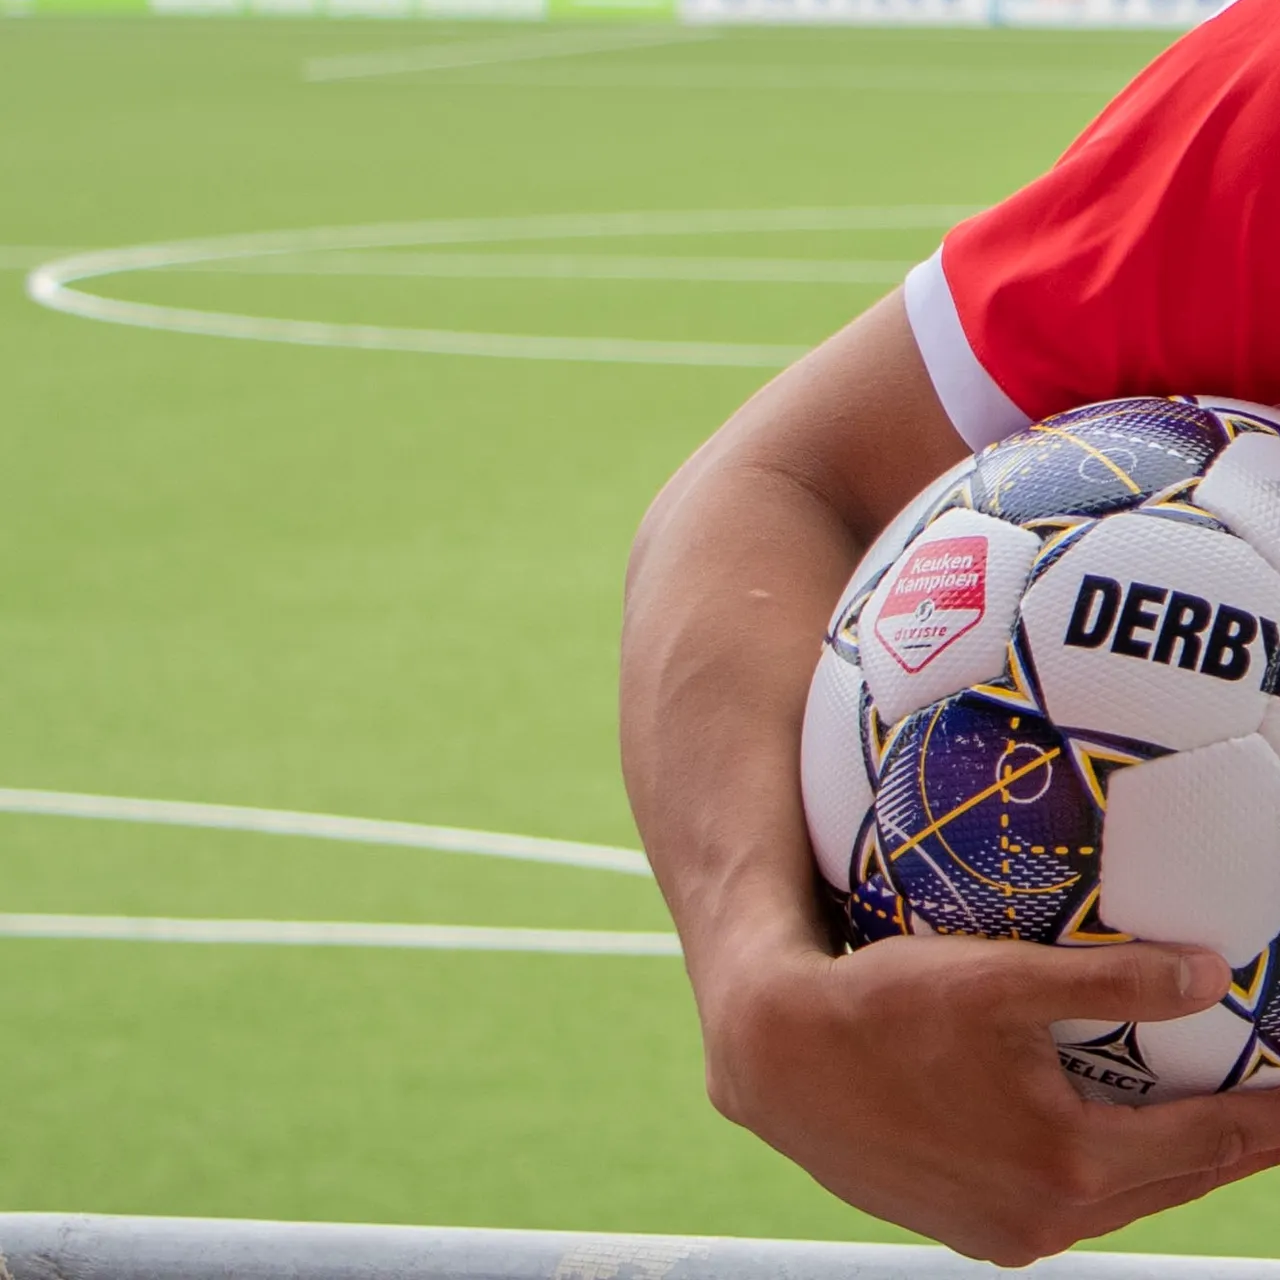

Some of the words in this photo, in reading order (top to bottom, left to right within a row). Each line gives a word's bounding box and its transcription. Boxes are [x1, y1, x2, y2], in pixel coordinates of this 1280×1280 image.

[911, 553, 974, 574] Keuken
[895, 569, 979, 595] Kampioen
[894, 624, 948, 642] divisie
